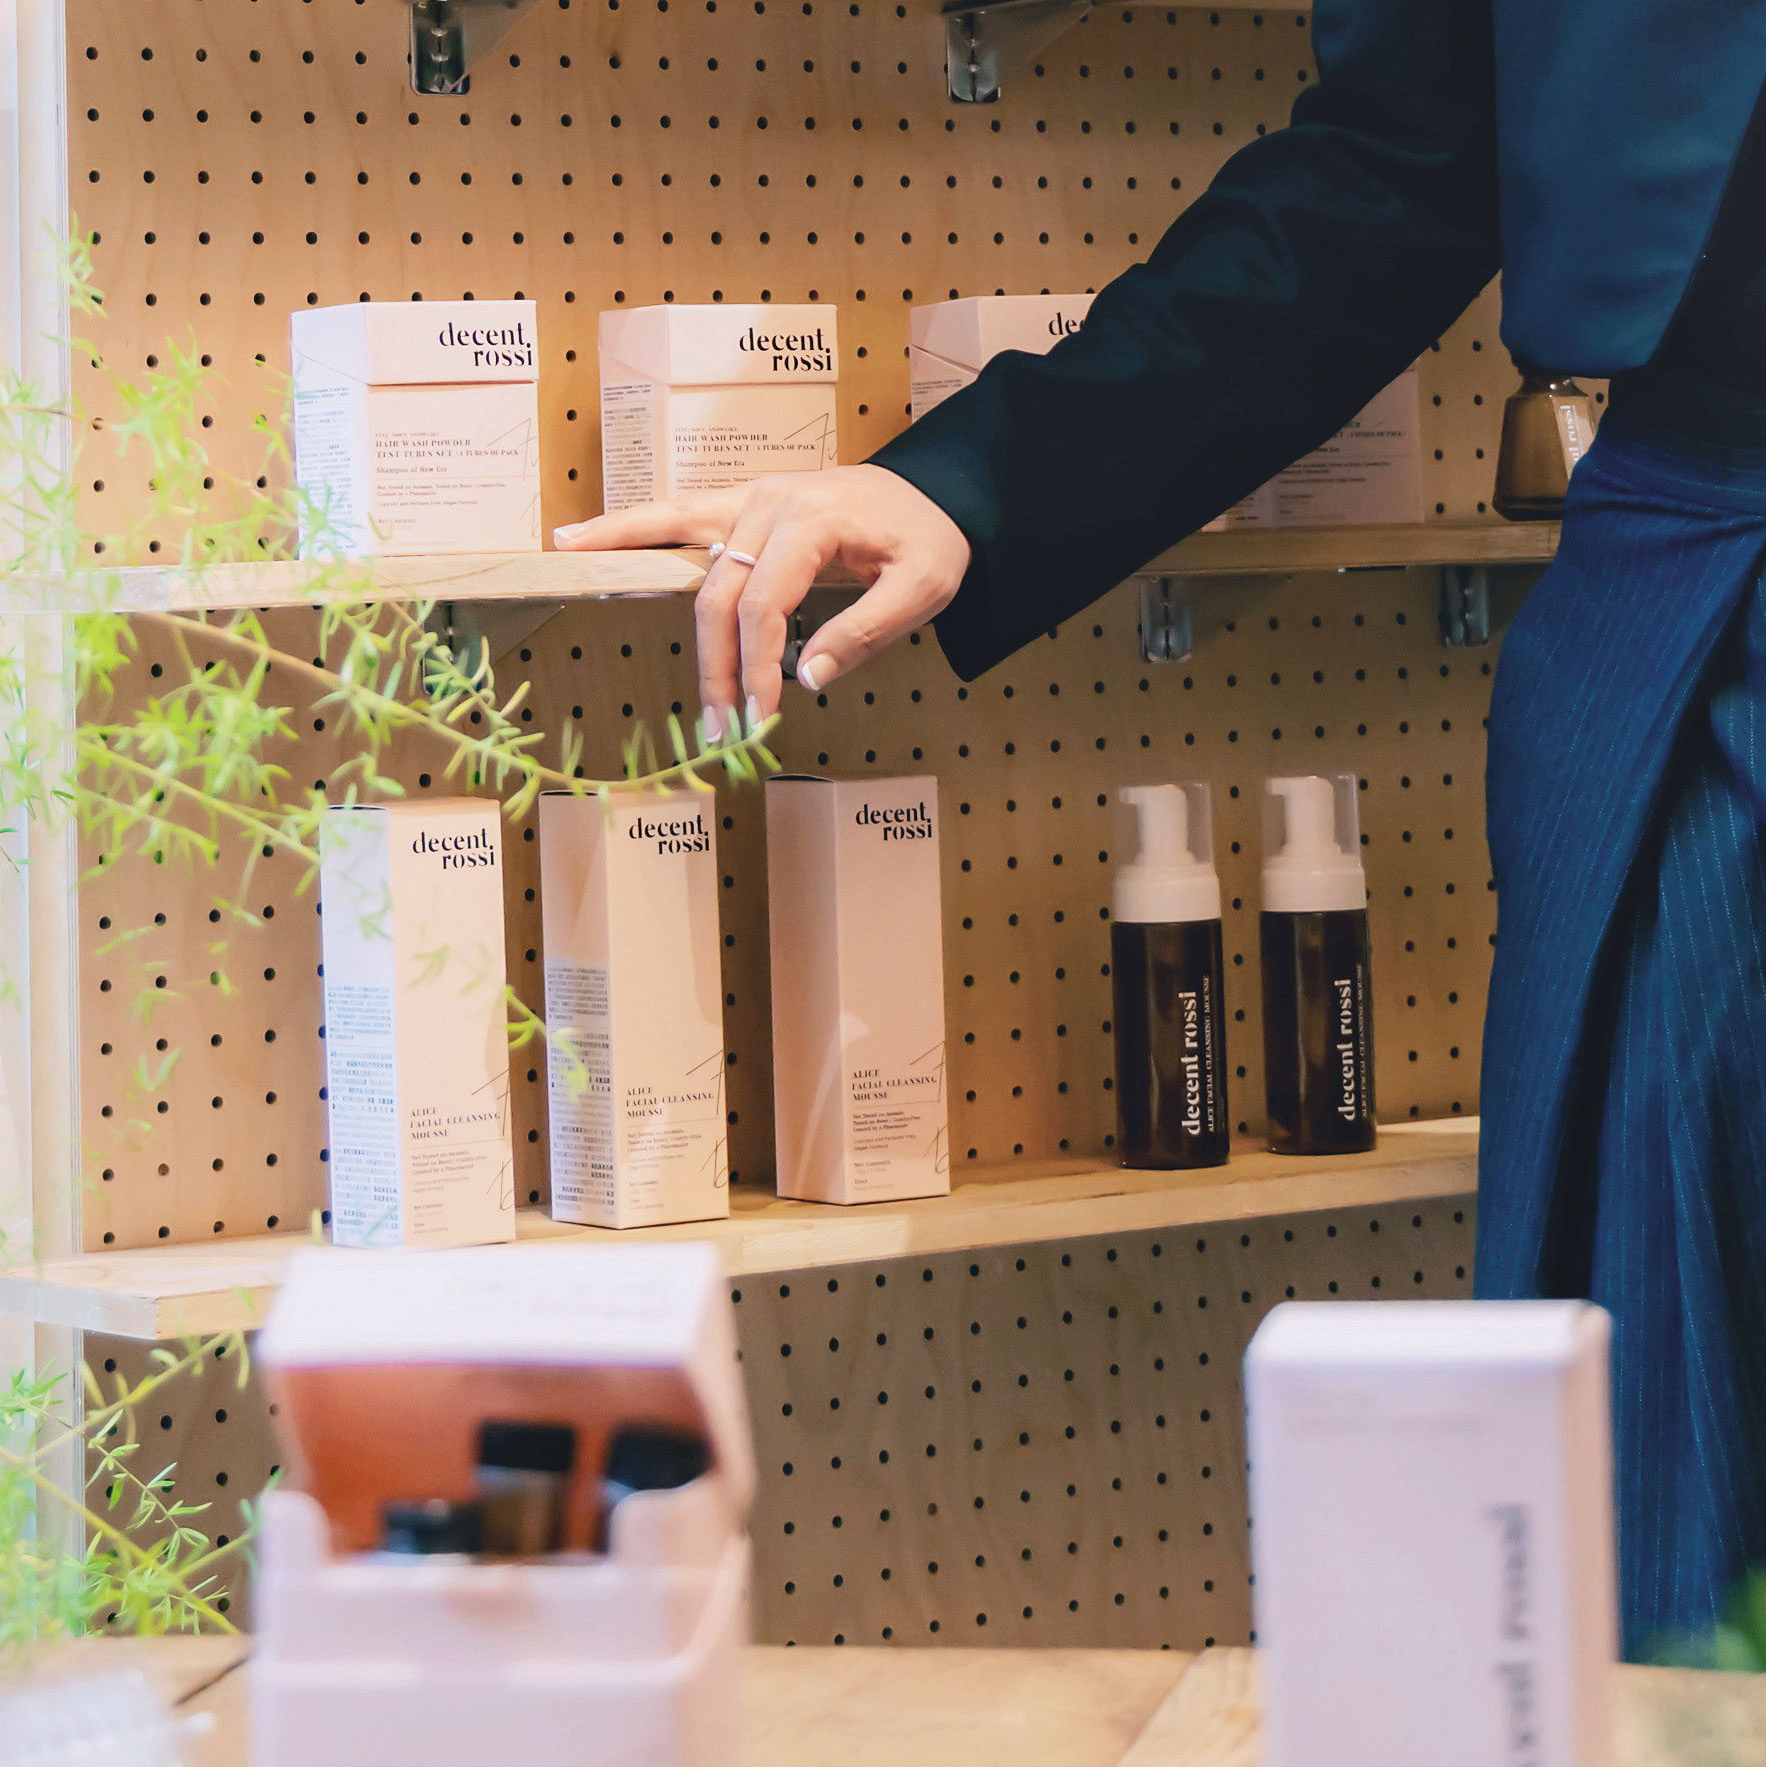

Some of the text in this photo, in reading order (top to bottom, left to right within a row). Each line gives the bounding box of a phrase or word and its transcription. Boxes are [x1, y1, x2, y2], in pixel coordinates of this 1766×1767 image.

[1048, 311, 1084, 336] de
[439, 321, 526, 347] decent
[738, 327, 825, 352] decent
[473, 342, 533, 367] rossi
[772, 347, 832, 371] rossi
[375, 439, 471, 448] HAIR WASH POWDER
[675, 434, 769, 443] HAIR WASH POWDER
[376, 450, 400, 459] TEST
[403, 450, 433, 458] TUBES
[436, 449, 454, 458] SET
[676, 445, 699, 453] TEST
[702, 444, 731, 452] TUBES
[733, 444, 750, 452] SET
[376, 466, 409, 475] Shampoo
[419, 465, 434, 473] New
[676, 460, 707, 469] Shampoo
[855, 801, 926, 825] decent
[628, 814, 704, 839] decent
[883, 818, 932, 841] rossi
[412, 828, 489, 854] decent
[658, 830, 710, 855] rossi
[442, 844, 495, 870] rossi
[1334, 979, 1356, 1121] decent rossi
[1178, 991, 1201, 1136] decent rossi
[852, 1068, 881, 1079] ALICE
[626, 1086, 653, 1096] ALICE
[852, 1076, 937, 1091] FACIAL CLEANSING
[626, 1092, 715, 1107] FACIAL CLEANSING
[852, 1092, 888, 1101] MOUSSE
[411, 1107, 436, 1117] ALICE
[627, 1108, 663, 1118] MOUSSE
[410, 1112, 501, 1129] FACIAL CLEANSING
[411, 1129, 449, 1140] MOUSSE
